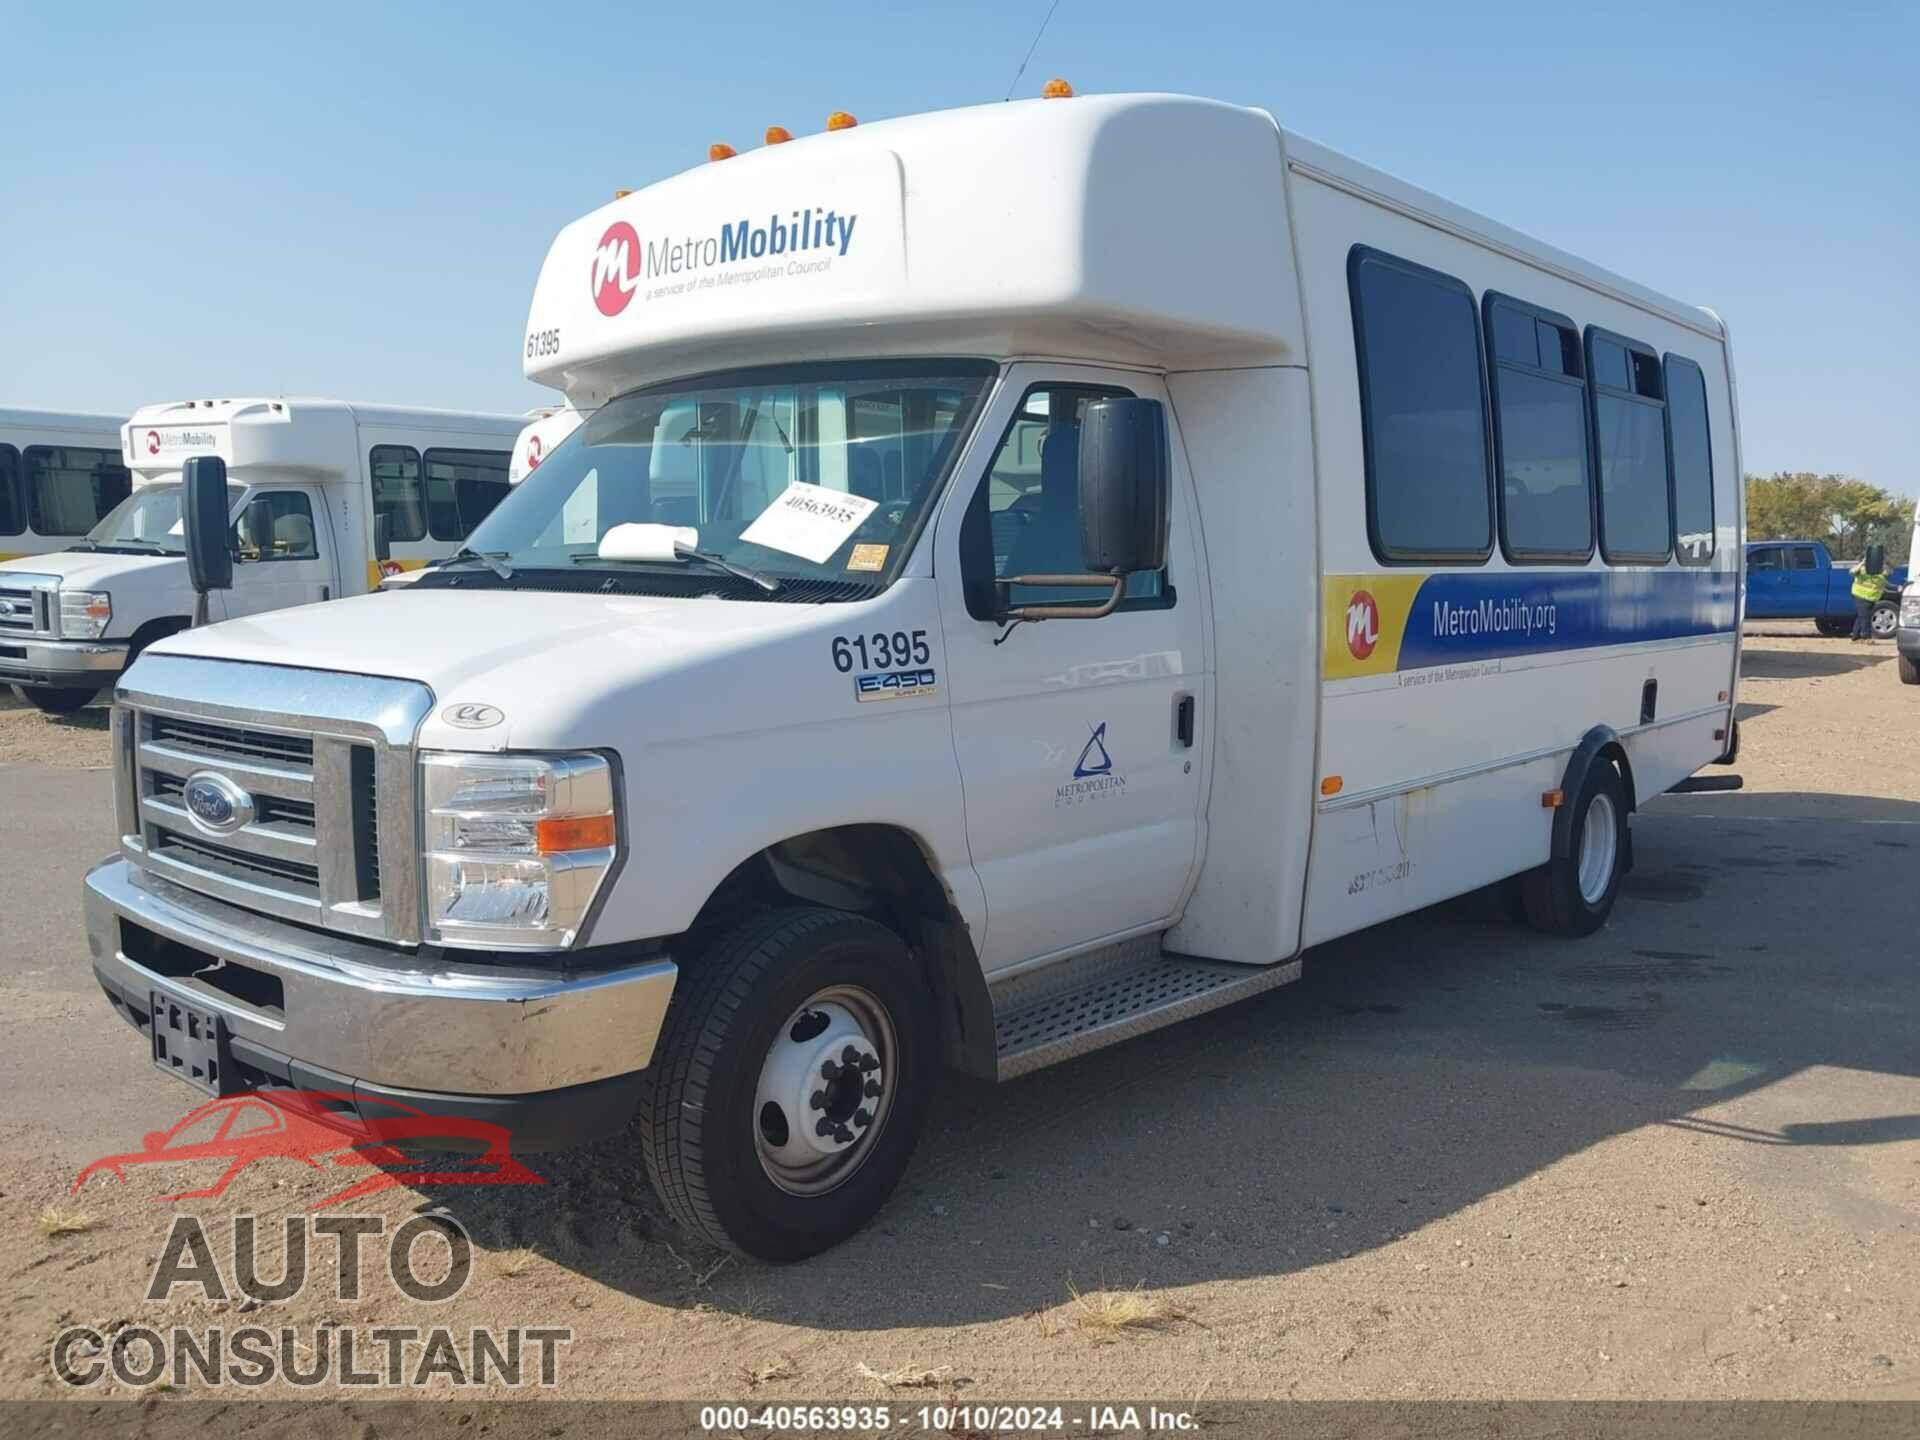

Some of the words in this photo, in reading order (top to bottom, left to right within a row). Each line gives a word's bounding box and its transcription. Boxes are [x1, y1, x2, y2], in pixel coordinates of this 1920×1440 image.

[647, 207, 856, 279] MetroMobility
[654, 284, 684, 299] service
[687, 279, 697, 292] of
[699, 276, 715, 289] the
[717, 265, 783, 287] Metropolitan
[787, 256, 832, 276] Council
[527, 328, 560, 358] 61395
[1433, 598, 1557, 637] MetroMobility.org
[831, 630, 930, 673] 61395
[193, 787, 225, 817] Ford
[1055, 776, 1127, 800] METROPOLITAN
